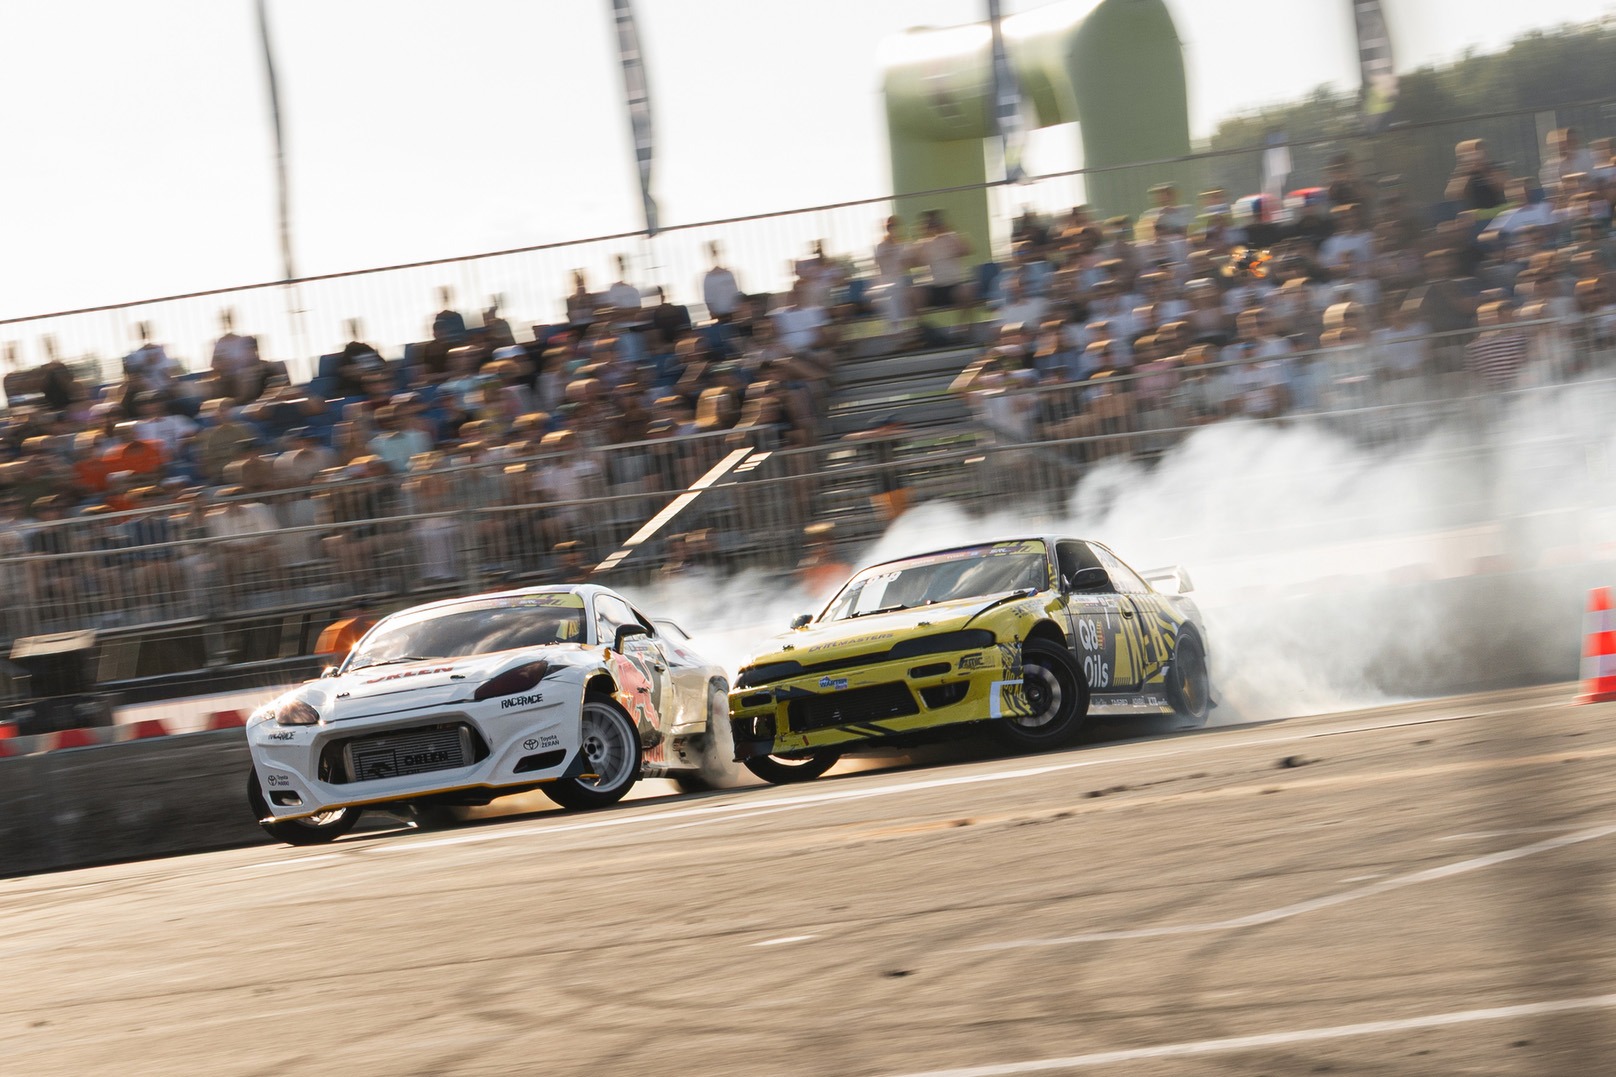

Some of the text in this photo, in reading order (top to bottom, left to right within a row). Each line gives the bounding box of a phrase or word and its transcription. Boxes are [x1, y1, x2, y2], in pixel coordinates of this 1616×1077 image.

[1079, 619, 1099, 652] Q8
[1084, 654, 1109, 688] Oils
[501, 693, 544, 709] RACERACE
